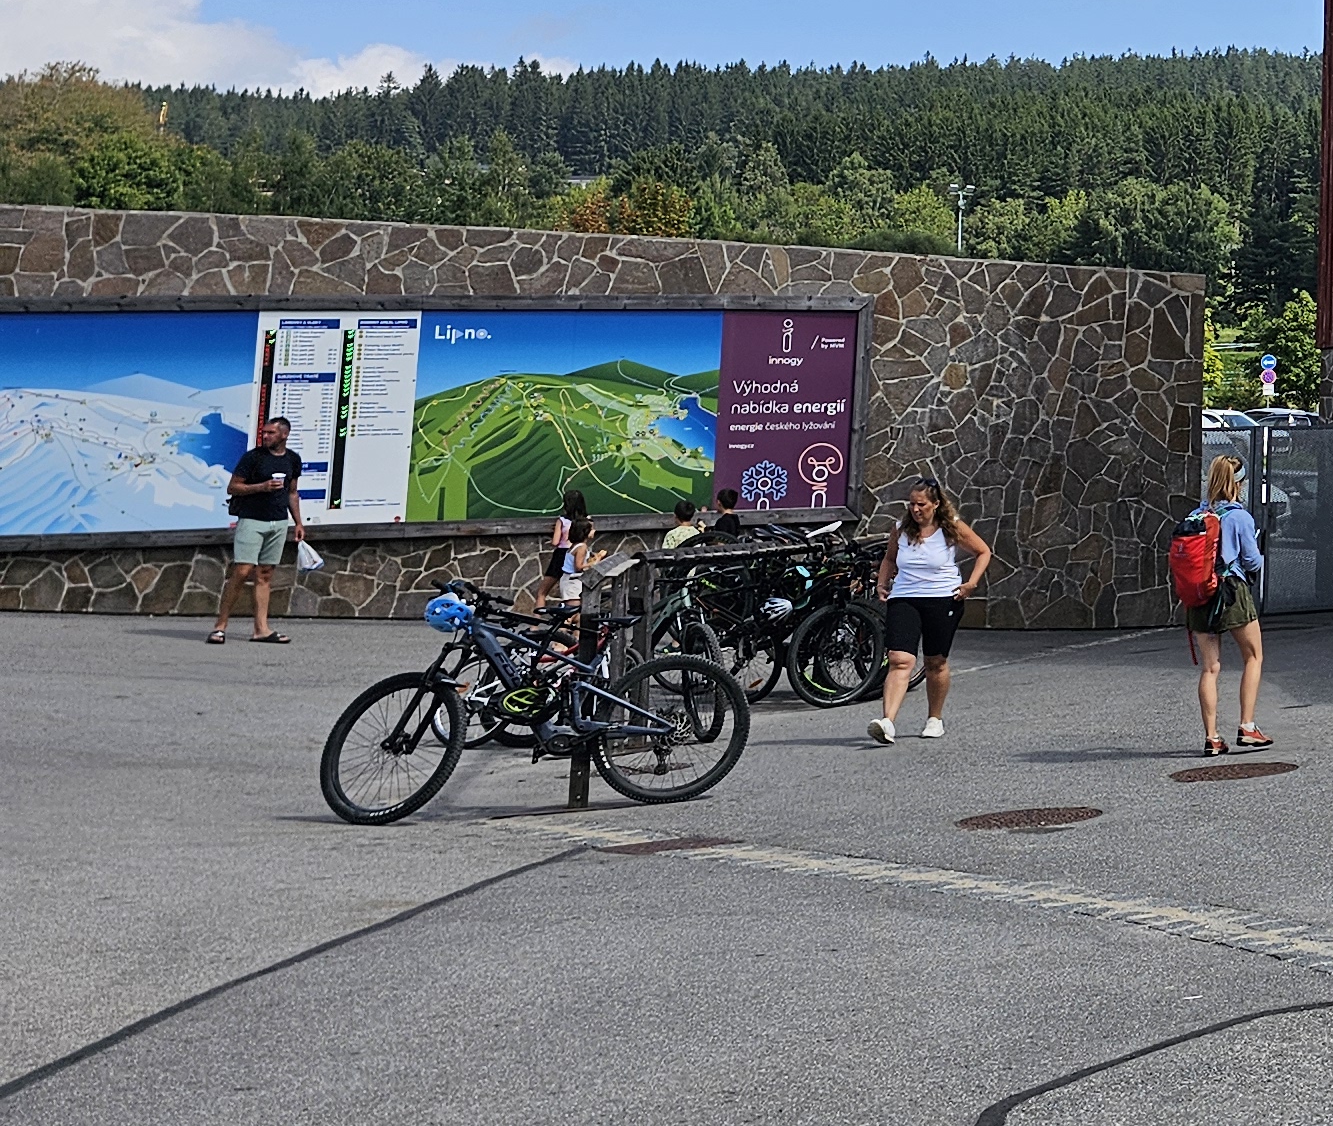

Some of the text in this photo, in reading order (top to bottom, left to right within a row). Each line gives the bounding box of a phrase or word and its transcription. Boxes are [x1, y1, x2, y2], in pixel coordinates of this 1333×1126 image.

[768, 355, 804, 367] innogy
[732, 379, 799, 397] Výhodná
[731, 399, 847, 416] nabídka energií
[729, 420, 837, 432] energie českého lyžování
